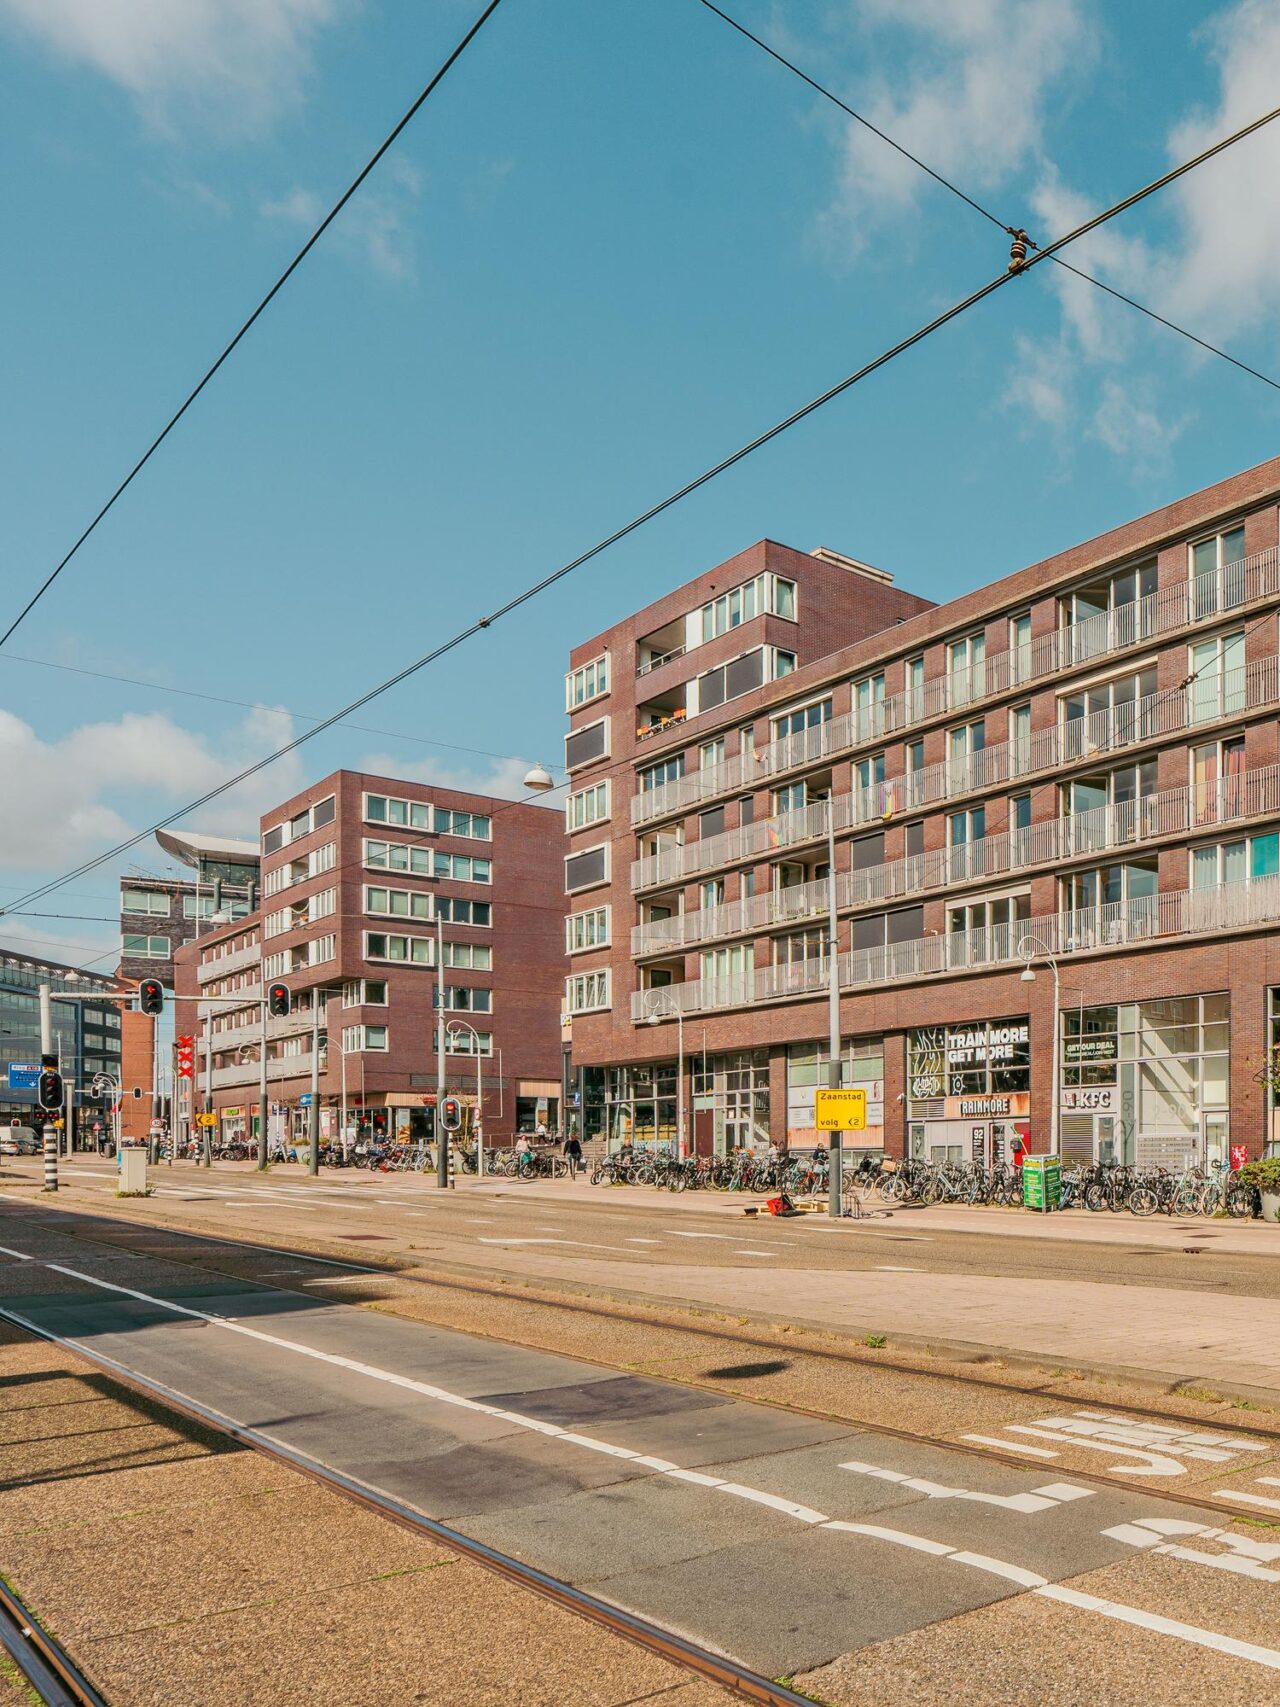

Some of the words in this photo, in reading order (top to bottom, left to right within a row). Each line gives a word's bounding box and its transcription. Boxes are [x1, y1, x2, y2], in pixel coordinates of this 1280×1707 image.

[948, 1031, 987, 1049] TRAIN
[989, 1026, 1028, 1046] MORE
[948, 1048, 974, 1063] GET
[976, 1044, 1013, 1061] MORE
[820, 1091, 862, 1100] Zaanstad
[1080, 1091, 1111, 1107] KFC
[820, 1119, 839, 1128] volg
[853, 1118, 860, 1126] 2
[974, 1129, 984, 1139] 92
